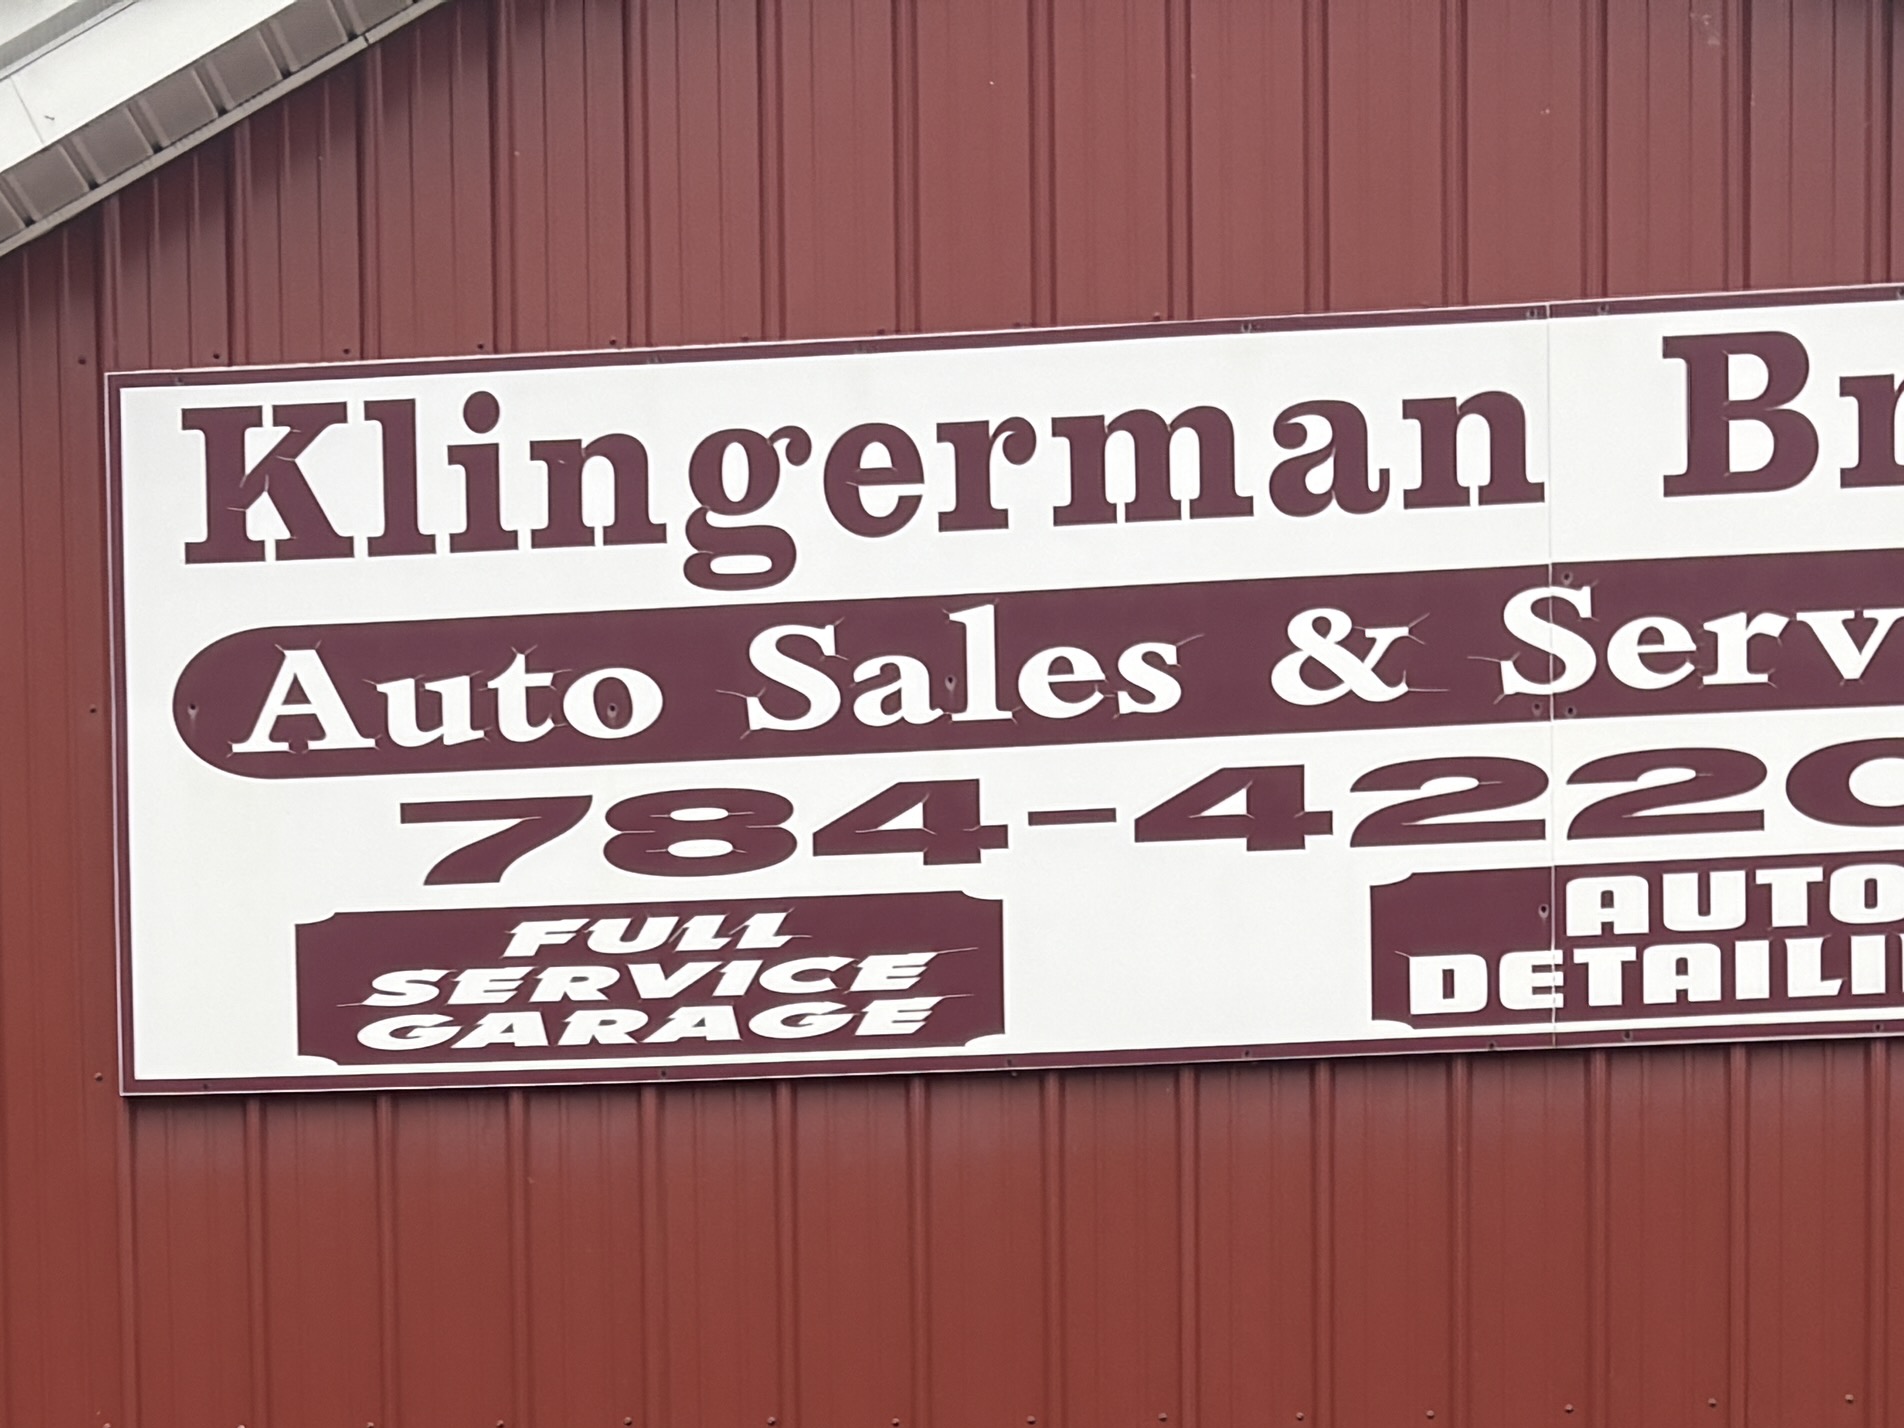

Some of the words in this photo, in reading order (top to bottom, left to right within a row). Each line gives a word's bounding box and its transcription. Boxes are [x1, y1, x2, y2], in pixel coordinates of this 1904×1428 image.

[180, 389, 1546, 591] Klingerman
[229, 647, 665, 754] Auto
[744, 603, 1184, 734] Sales
[1270, 606, 1411, 707] &
[501, 911, 796, 958] FULL
[362, 951, 939, 1008] SERVICE
[356, 997, 943, 1052] GARAGE
